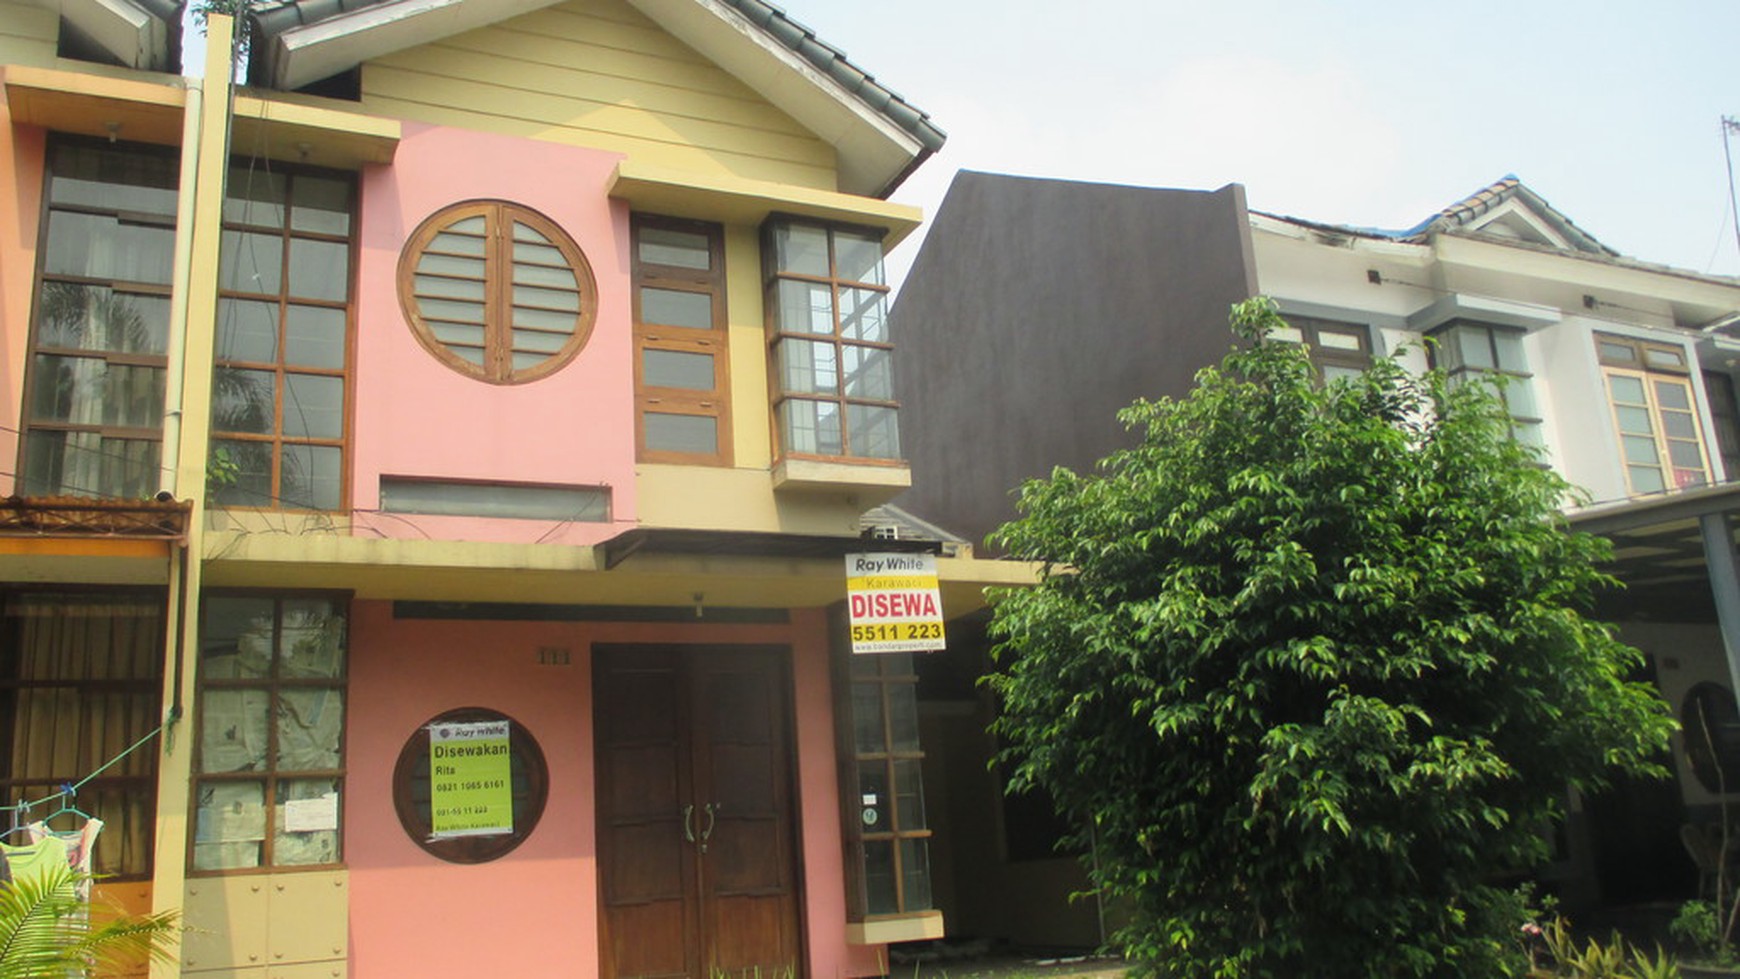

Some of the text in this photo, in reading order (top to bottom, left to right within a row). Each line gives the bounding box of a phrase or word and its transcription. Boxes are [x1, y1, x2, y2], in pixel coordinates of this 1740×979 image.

[856, 557, 924, 572] Ray White
[866, 577, 922, 589] Karawaci
[851, 593, 938, 618] DISEWA
[853, 623, 941, 641] 5511 223
[434, 743, 508, 759] Disewakan
[435, 766, 455, 775] Rita
